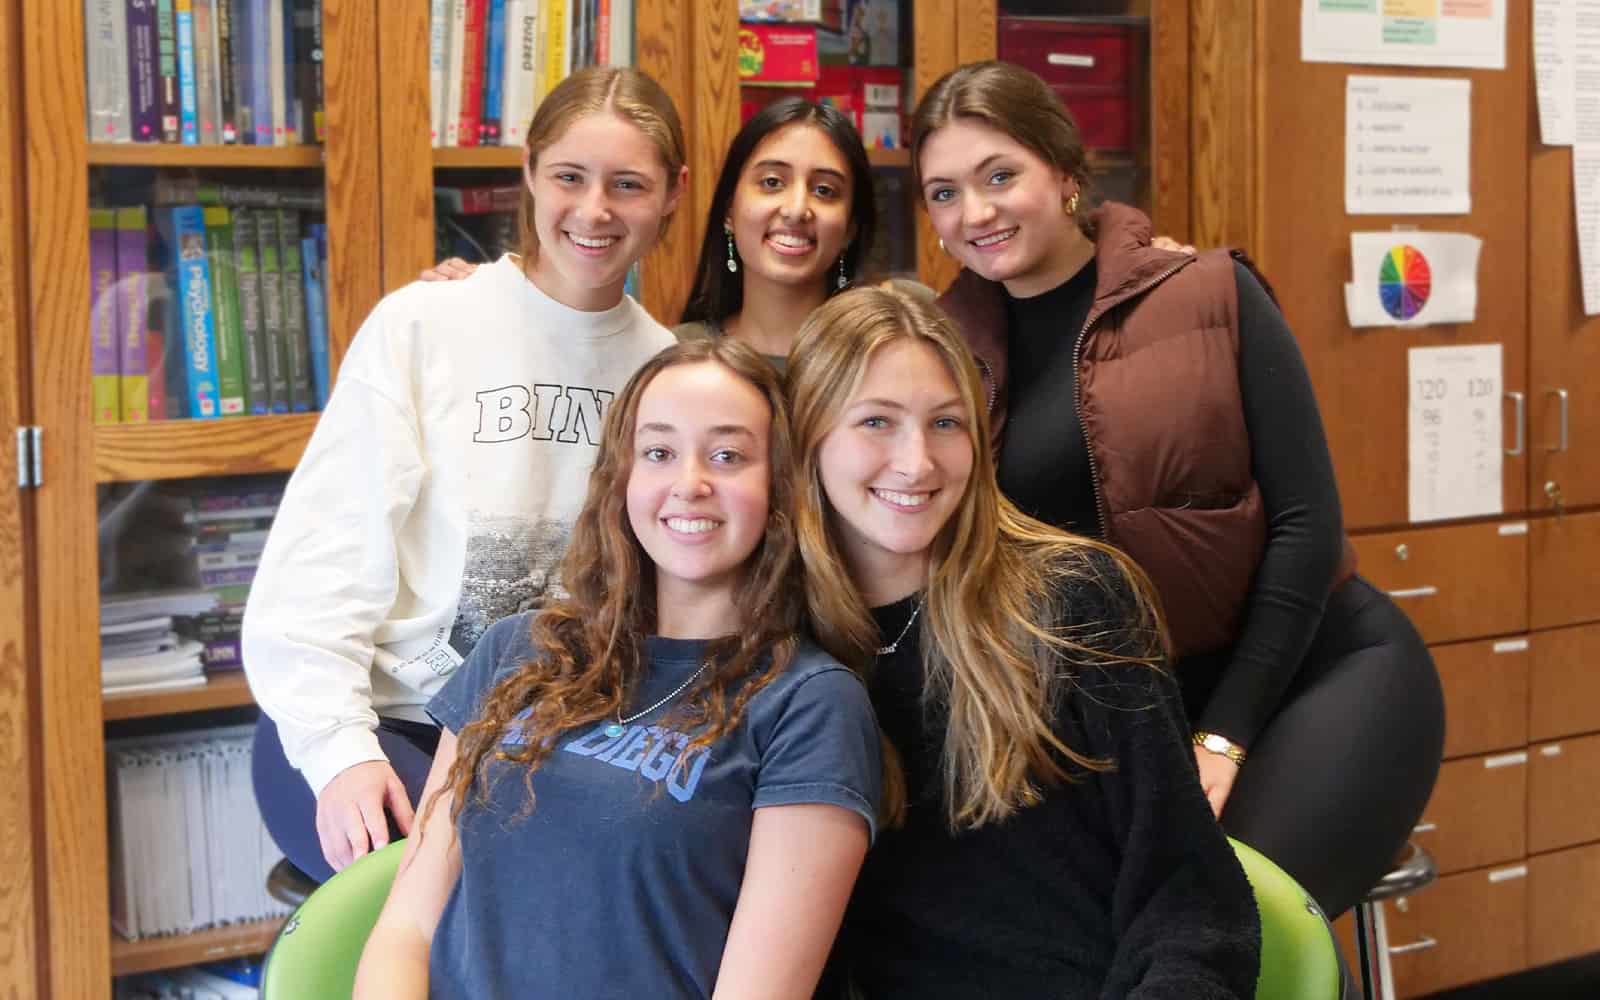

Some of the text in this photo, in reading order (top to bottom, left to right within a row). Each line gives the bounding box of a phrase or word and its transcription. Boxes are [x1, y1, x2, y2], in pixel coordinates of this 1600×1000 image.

[521, 15, 536, 72] buzzed
[187, 265, 209, 373] Psychology
[563, 720, 712, 803] DIEGO
